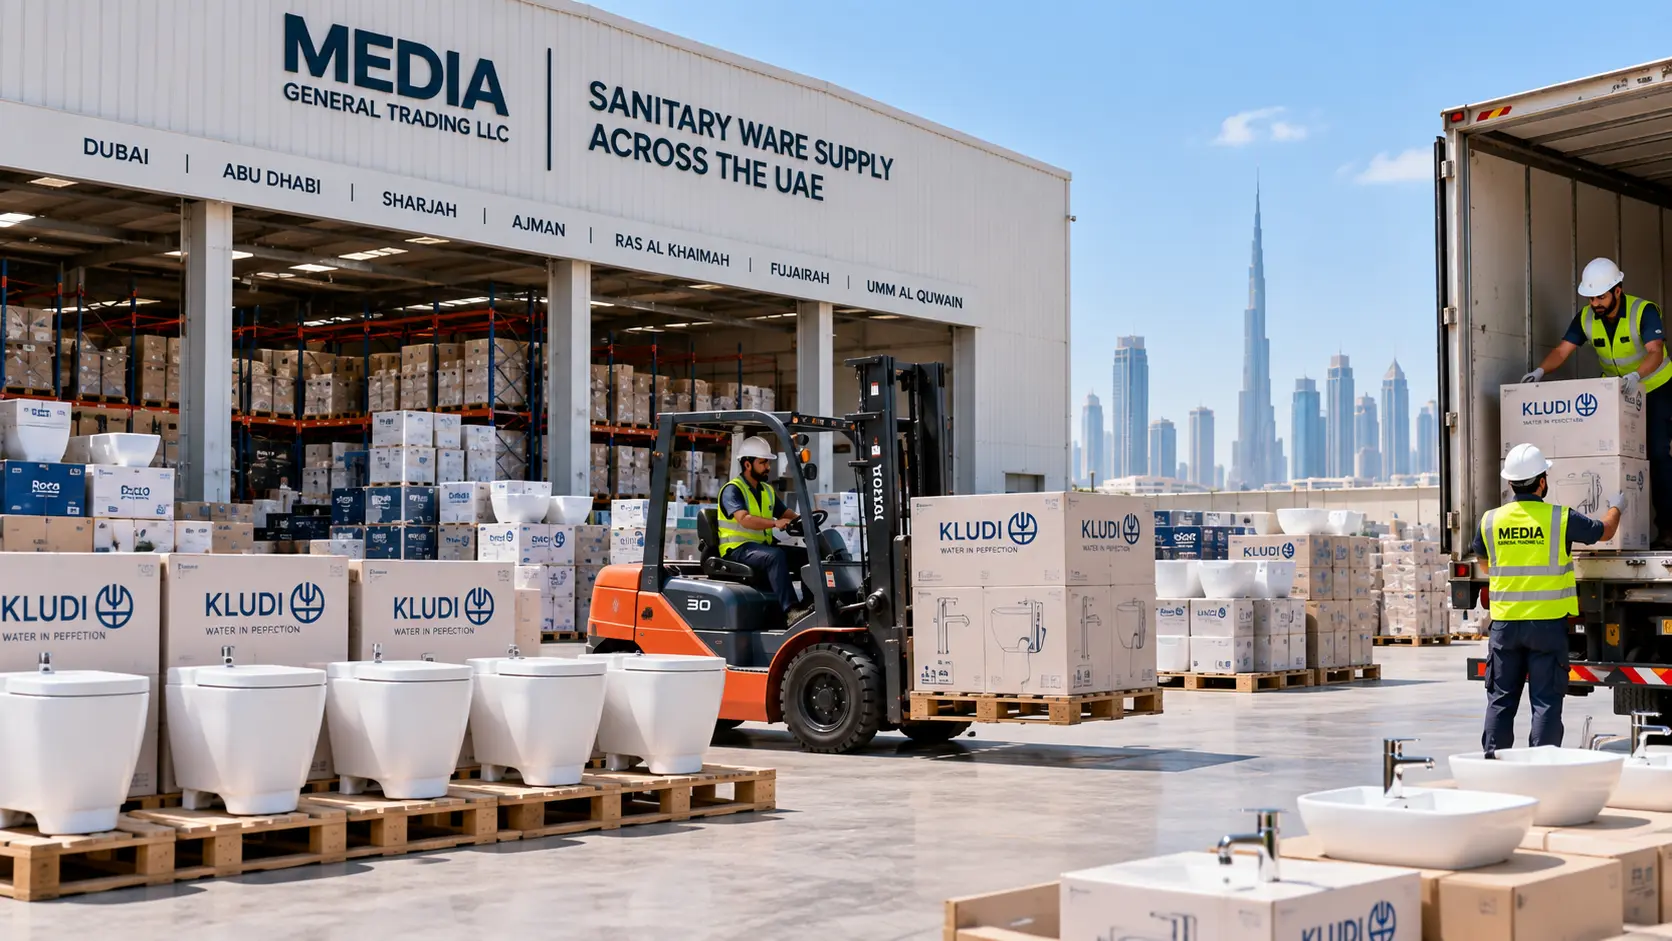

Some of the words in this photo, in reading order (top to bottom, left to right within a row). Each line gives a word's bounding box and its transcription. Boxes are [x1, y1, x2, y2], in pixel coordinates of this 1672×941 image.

[284, 12, 510, 117] MEDIA
[283, 81, 382, 119] GENERAL
[386, 102, 471, 135] TRADING
[476, 120, 510, 143] LLC
[588, 80, 732, 142] SANITARY
[738, 117, 809, 161] WARE
[814, 139, 894, 181] SUPPLY
[83, 137, 149, 165] DUBAI
[588, 123, 709, 176] ACROSS
[715, 150, 768, 189] THE
[775, 164, 825, 202] UAE
[222, 162, 261, 184] ABU
[266, 170, 321, 195] DHABI
[382, 190, 457, 219] SHARJAH
[511, 214, 566, 237] AJMAN
[615, 233, 643, 251] RAS
[646, 239, 664, 255] AL
[668, 243, 730, 267] KHAIMAH
[770, 262, 830, 285] FUJAIRAH
[867, 279, 896, 297] UMM
[898, 286, 914, 300] AL
[916, 289, 963, 309] QUWAIN
[1522, 399, 1571, 416] KLUDI
[939, 520, 1002, 541] KLUDI
[1081, 519, 1120, 539] KLUDI
[1498, 526, 1545, 540] MEDIA
[940, 546, 965, 554] WATER
[1243, 545, 1280, 558] KLUDI
[2, 595, 87, 622] KLUDI
[205, 592, 283, 617] KLUDI
[393, 596, 459, 620] KLUDI
[687, 598, 711, 611] 30
[2, 632, 37, 642] WATER
[40, 632, 50, 641] IN
[205, 626, 236, 635] WATER
[239, 626, 248, 634] IN
[394, 628, 420, 636] WATER
